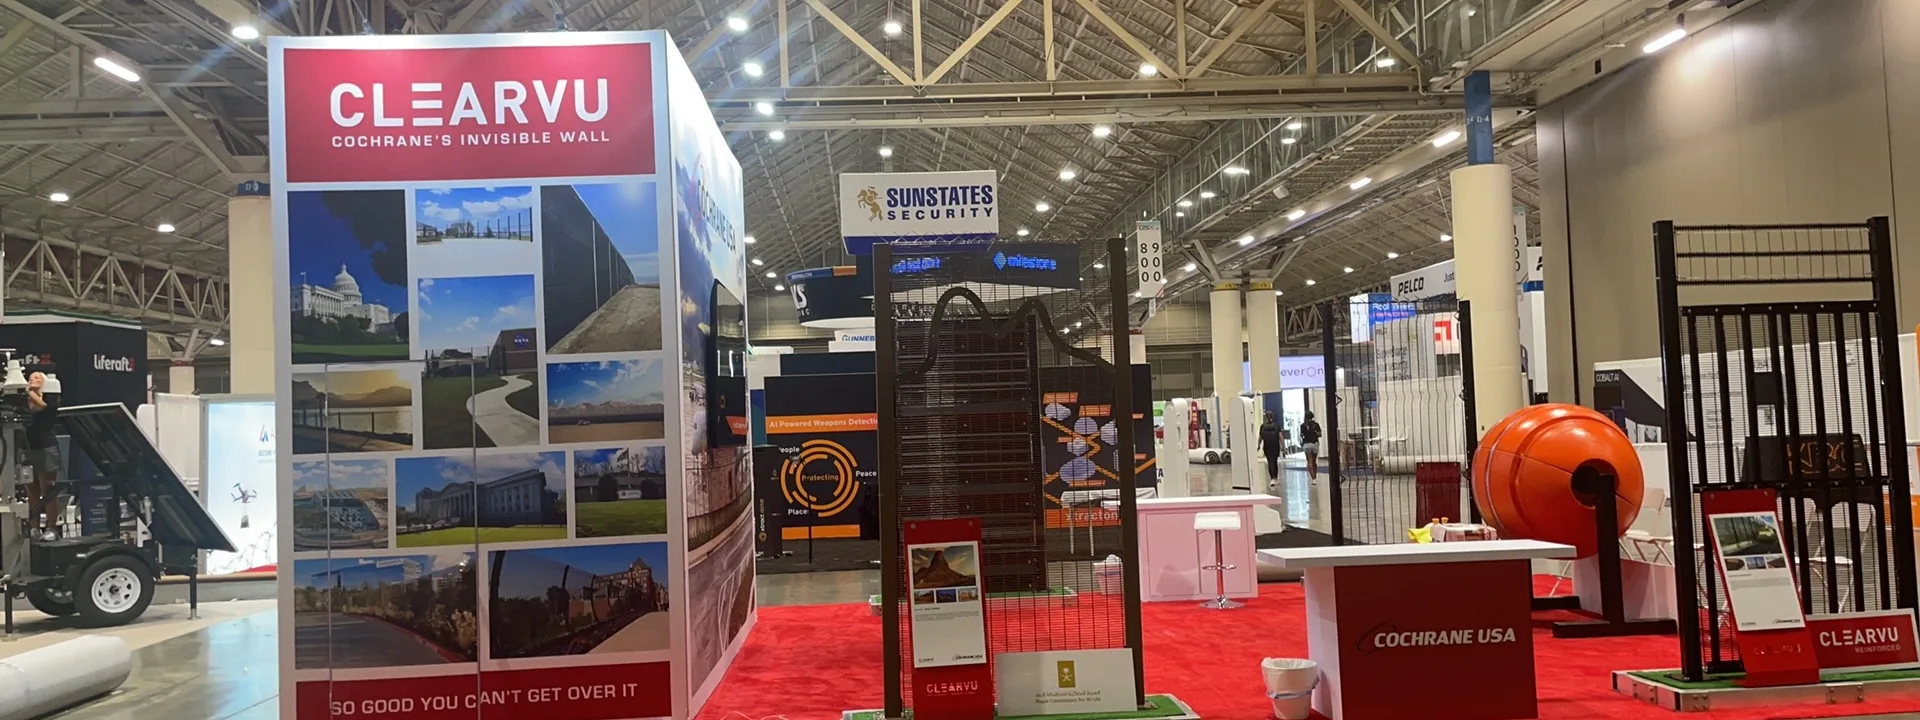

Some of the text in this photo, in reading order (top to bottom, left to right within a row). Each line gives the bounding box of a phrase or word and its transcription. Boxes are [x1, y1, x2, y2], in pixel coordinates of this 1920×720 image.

[330, 78, 608, 127] CLEARVU
[331, 130, 610, 147] COCHRANE'S INVISIBLE WALL
[887, 185, 993, 207] SUNSTATES
[888, 207, 993, 220] SECURITY
[1398, 277, 1424, 296] PELCO
[842, 334, 875, 342] GUNNEB
[780, 420, 812, 428] Powered
[813, 419, 847, 428] Weapons
[848, 418, 878, 426] Detecti
[779, 446, 800, 454] eople
[801, 474, 839, 482] Protecting
[1374, 628, 1516, 648] COCHRANE USA
[1820, 627, 1899, 646] CLEARVU
[1855, 644, 1901, 653] REINFORCED
[926, 680, 978, 694] CLEARVU
[331, 683, 637, 715] SO GOOD YOU CAN'T GET OVER IT
